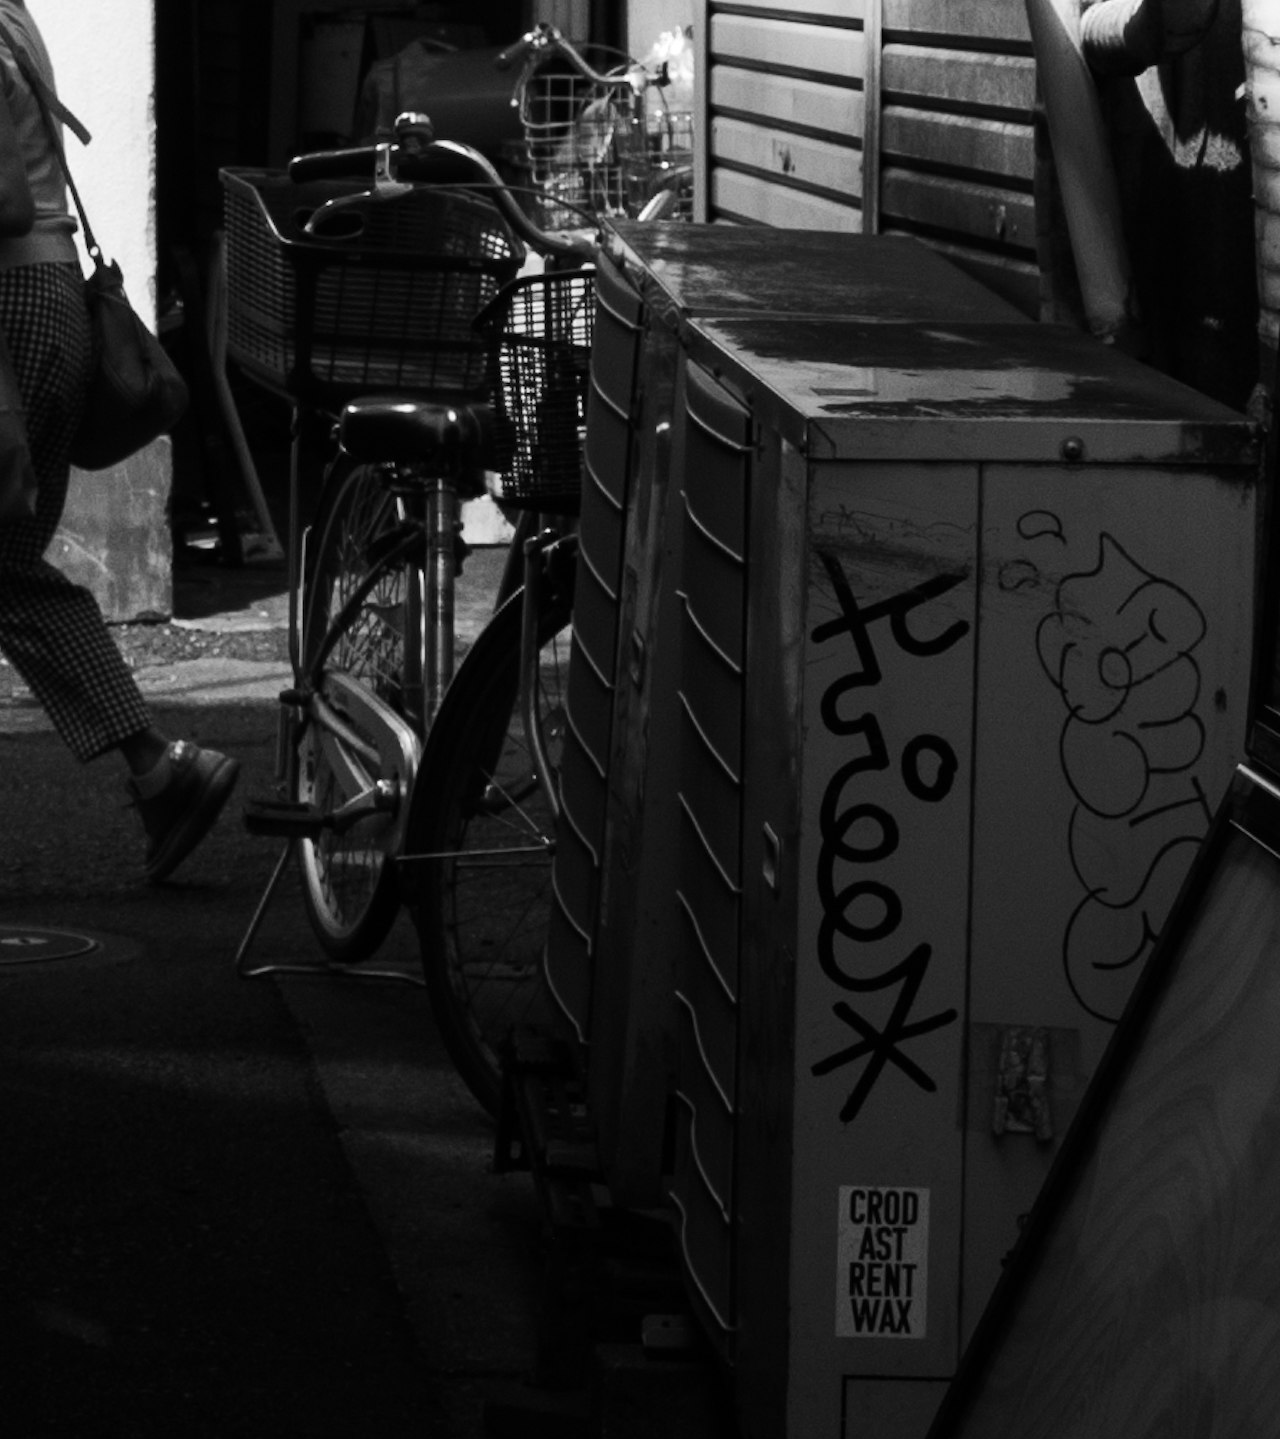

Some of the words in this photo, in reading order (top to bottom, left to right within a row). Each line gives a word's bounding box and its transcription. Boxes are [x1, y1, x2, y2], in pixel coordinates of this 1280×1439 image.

[850, 1189, 919, 1225] CROD
[859, 1227, 907, 1260] AST
[849, 1262, 917, 1297] RENT
[851, 1299, 913, 1334] WAX
